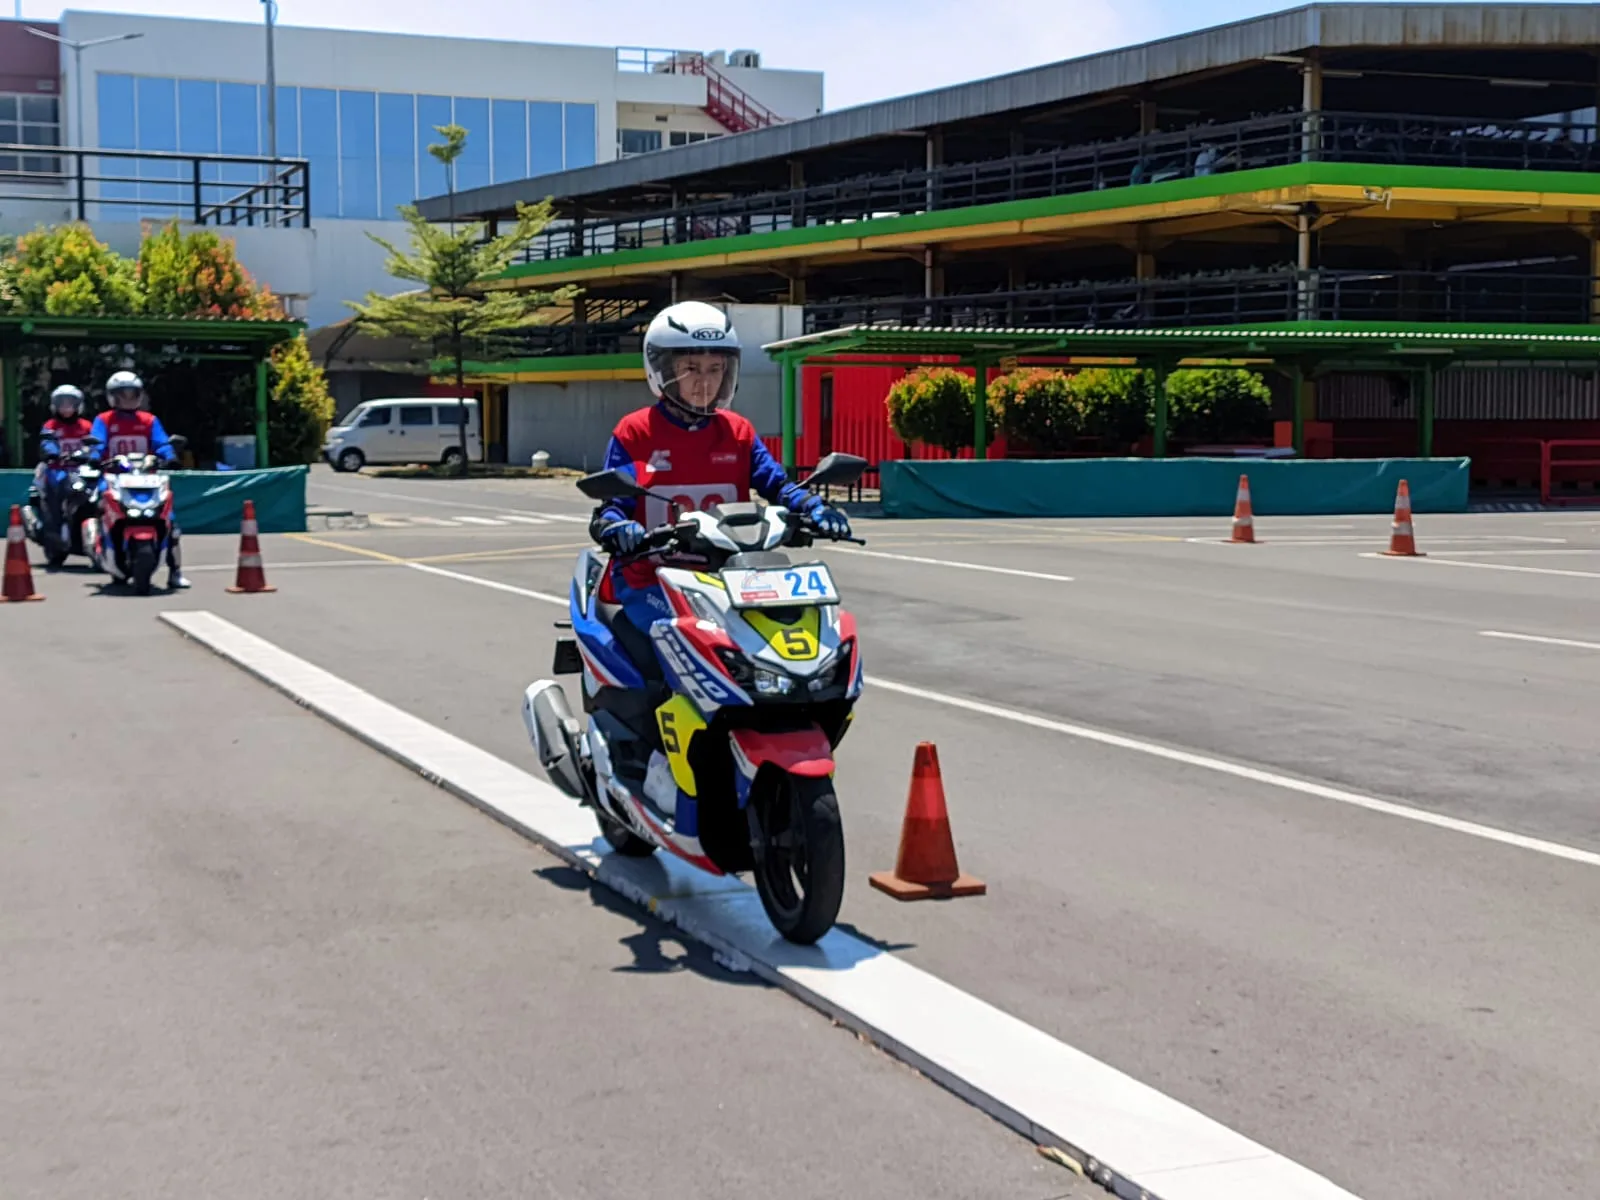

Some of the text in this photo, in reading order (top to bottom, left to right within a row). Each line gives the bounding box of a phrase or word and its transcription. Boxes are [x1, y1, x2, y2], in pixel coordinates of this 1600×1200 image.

[696, 330, 721, 340] KYT
[784, 571, 827, 596] 24
[781, 627, 811, 655] 5
[661, 711, 680, 753] 5
